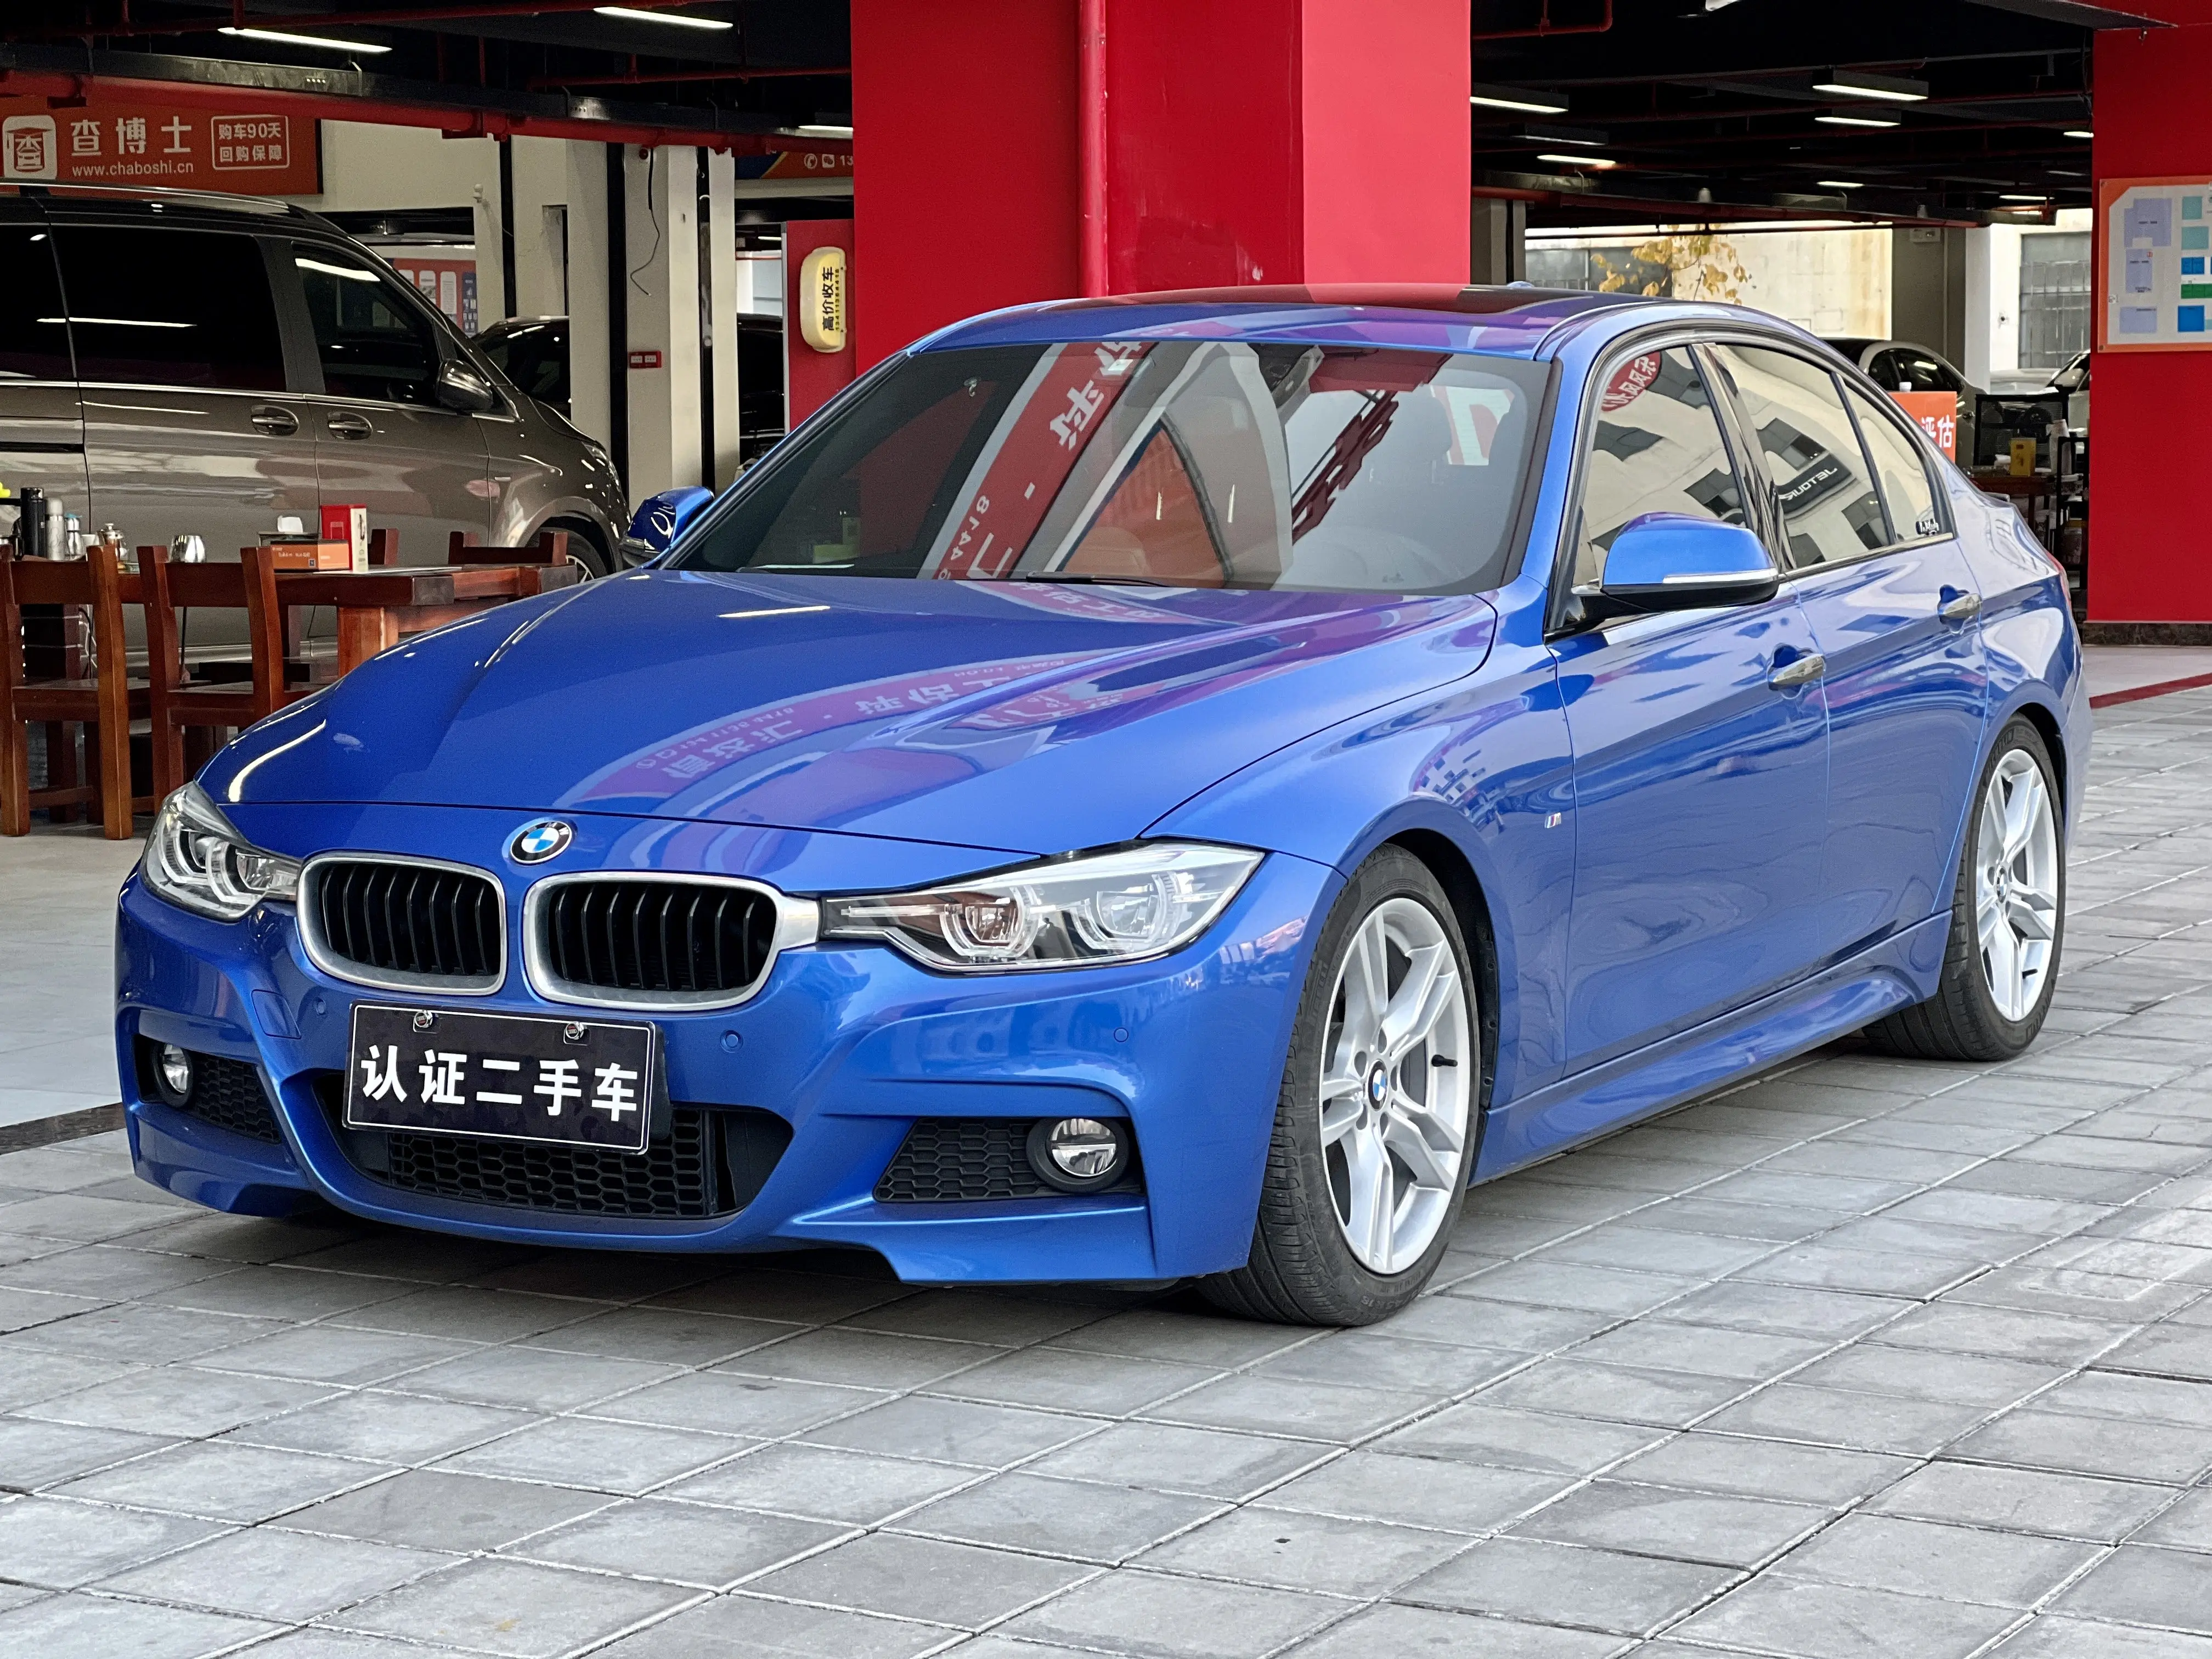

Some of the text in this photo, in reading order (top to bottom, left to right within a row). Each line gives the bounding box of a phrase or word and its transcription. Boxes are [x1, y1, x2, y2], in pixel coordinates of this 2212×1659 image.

[70, 116, 192, 156] 查博士
[219, 122, 281, 140] 购车90天
[72, 159, 195, 176] www.chaboshi.cn
[219, 144, 282, 162] 回购保障
[822, 267, 834, 331] 高价收车
[360, 1045, 638, 1122] 认证二手车
